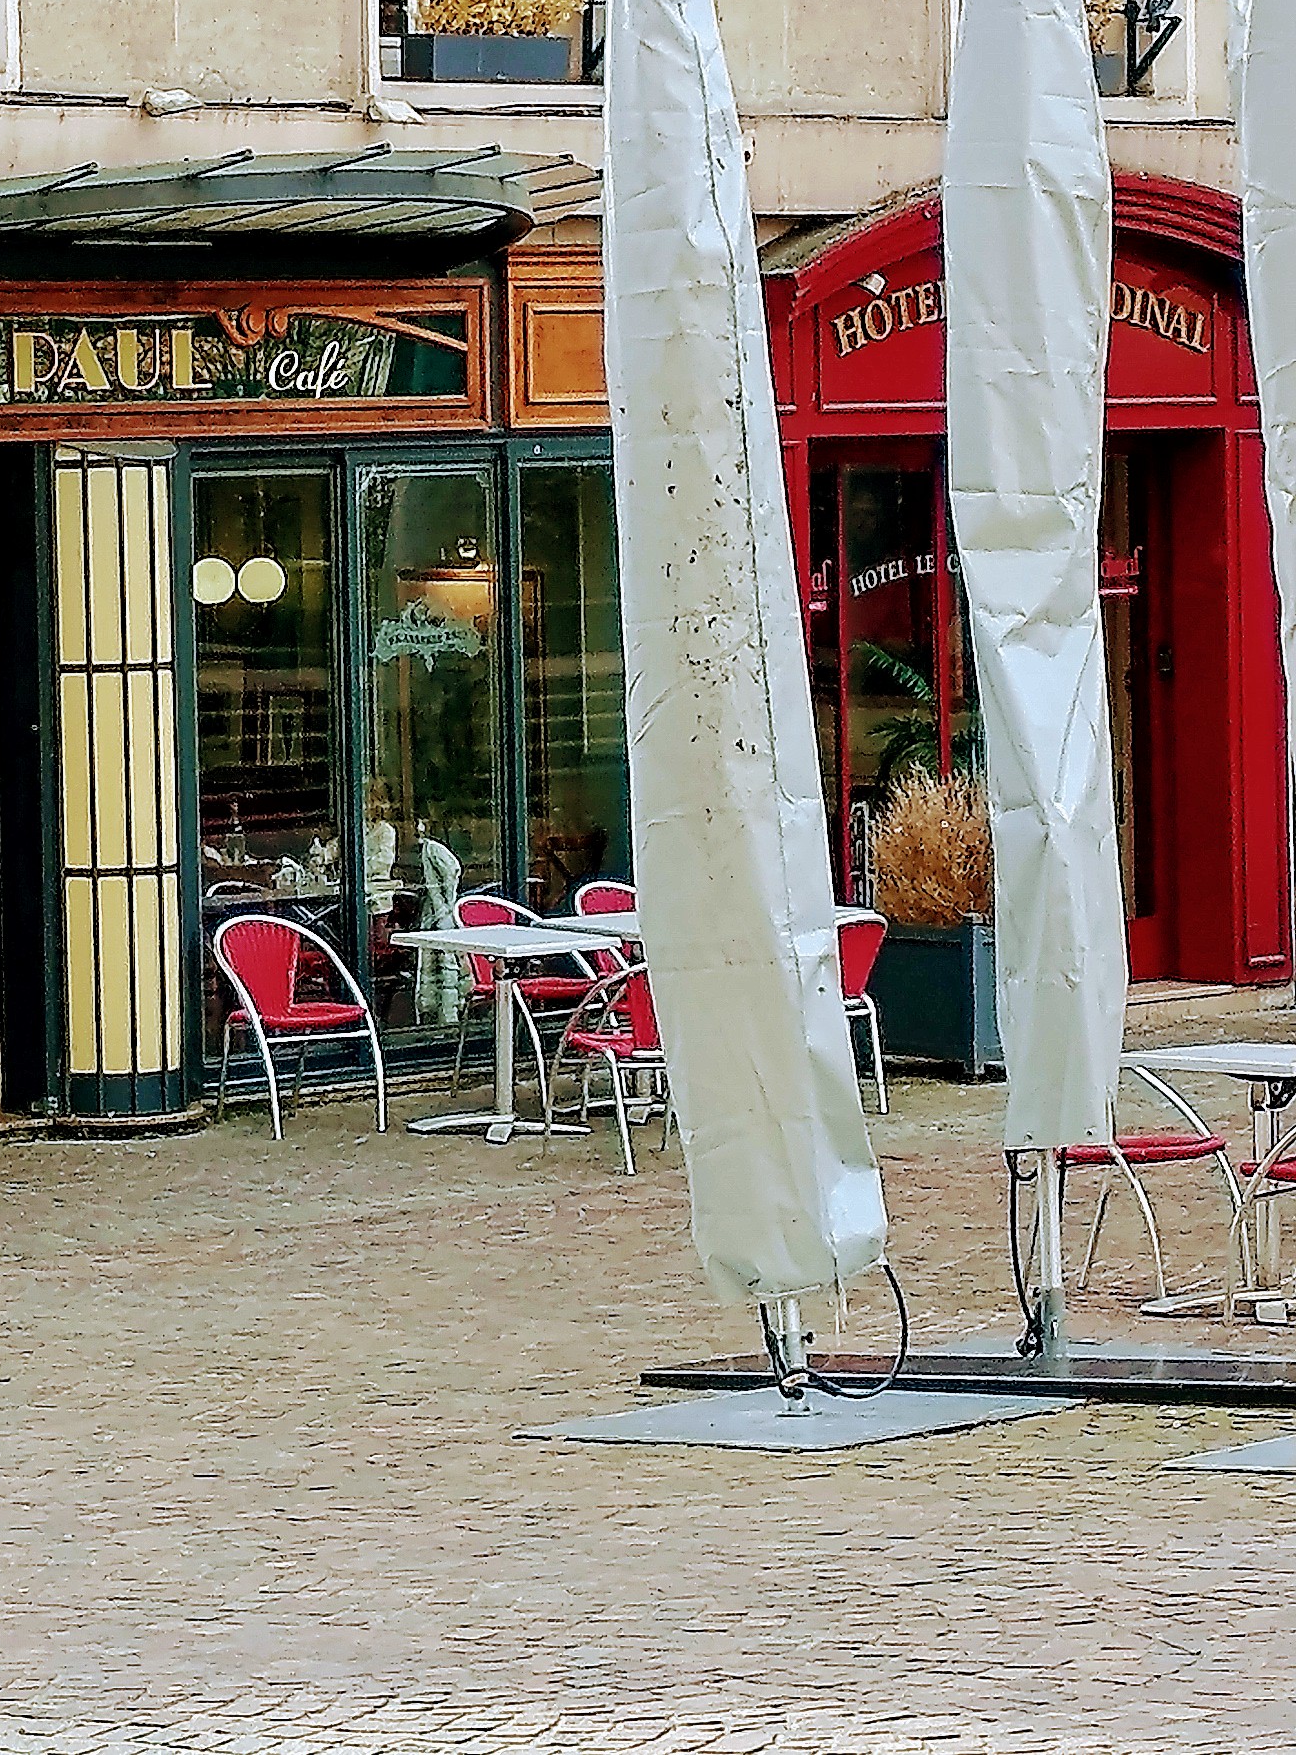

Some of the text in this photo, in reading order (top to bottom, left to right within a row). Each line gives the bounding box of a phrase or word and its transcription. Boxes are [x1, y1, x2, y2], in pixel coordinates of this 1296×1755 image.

[829, 282, 945, 358] HOTE
[12, 328, 213, 392] PAUL
[268, 340, 351, 399] Café
[852, 559, 908, 597] HOTEL
